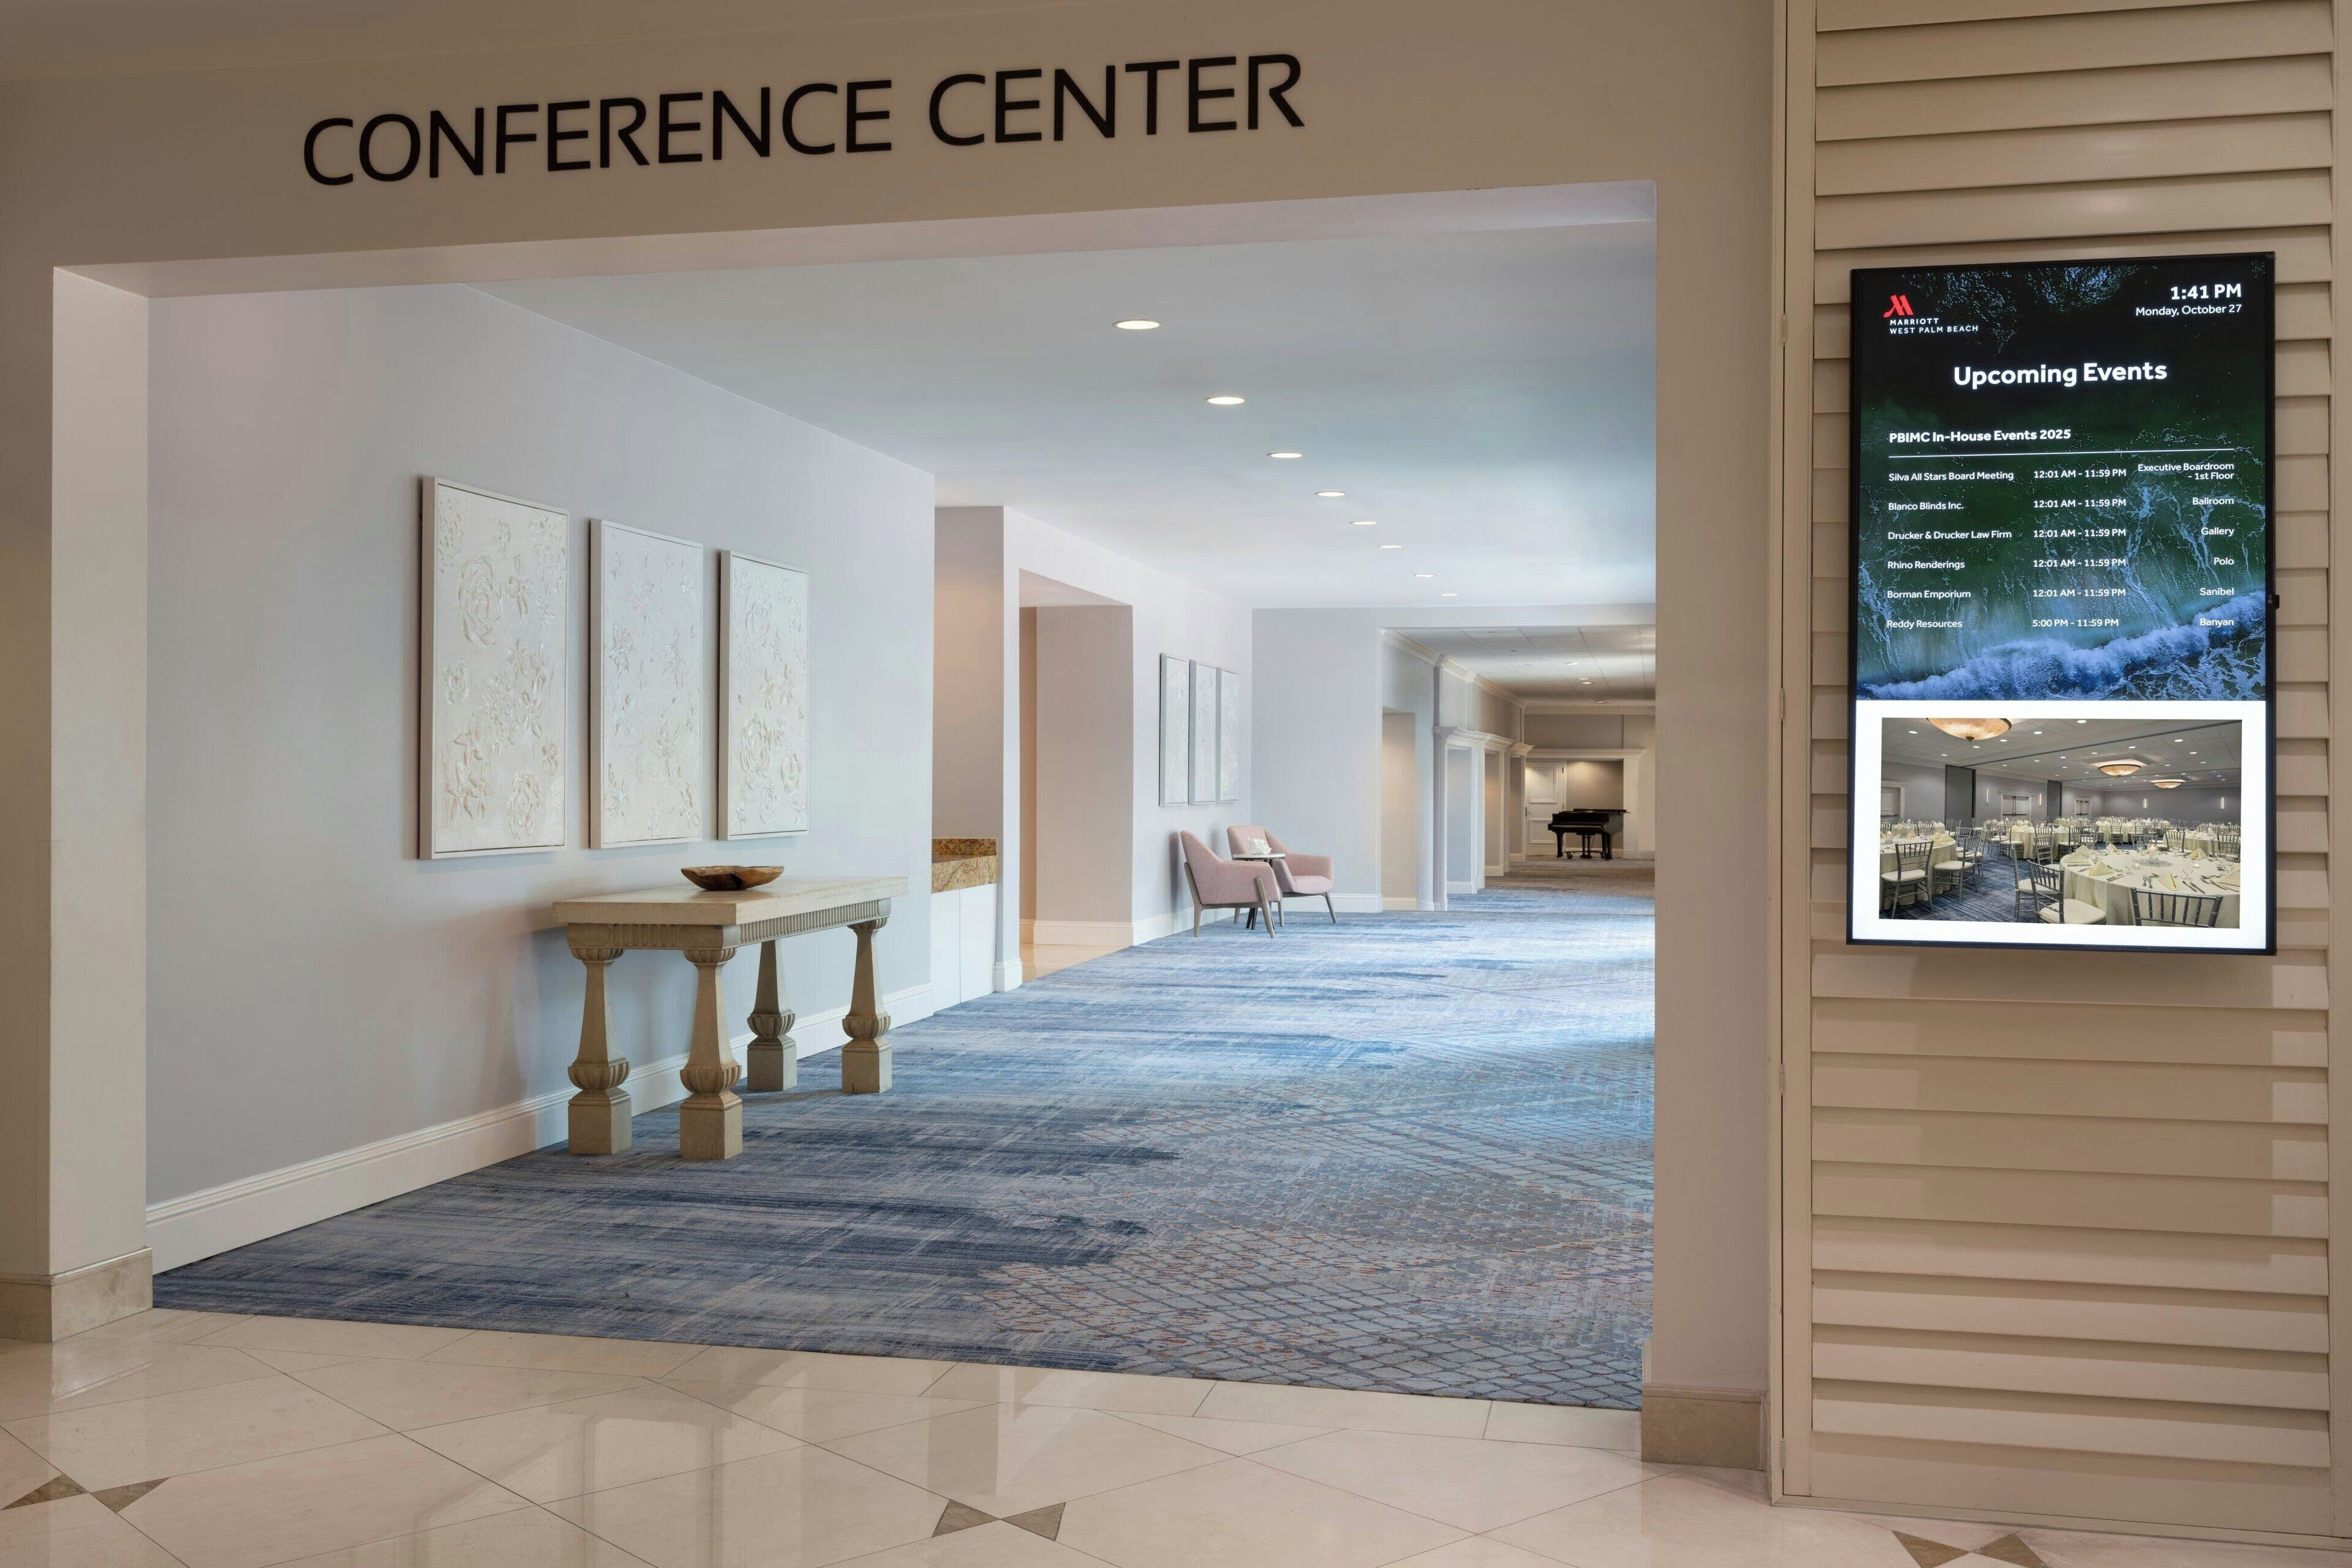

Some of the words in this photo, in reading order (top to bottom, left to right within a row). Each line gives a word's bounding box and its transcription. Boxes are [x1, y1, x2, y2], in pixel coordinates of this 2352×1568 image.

[304, 80, 891, 186] CONFERENCE
[929, 54, 1305, 146] CENTER
[2170, 285, 2209, 300] 1:41
[2214, 283, 2241, 298] PM
[2136, 306, 2179, 317] Monday,
[2181, 304, 2226, 314] October
[2228, 304, 2241, 312] 27
[1954, 364, 2076, 389] Upcoming
[2084, 362, 2167, 381] Events
[1889, 432, 1930, 443] PBIMC
[1932, 431, 1991, 442] In-House
[1994, 430, 2037, 440] Events
[2040, 429, 2070, 439] 2025
[1977, 471, 2013, 481] Meeting
[2111, 498, 2126, 507] PM
[2192, 496, 2234, 505] Ballroom
[2201, 527, 2234, 537] Gallery
[1915, 560, 1965, 570] Renderings
[1887, 590, 1922, 598] Borman
[1923, 590, 1970, 600] Emporium
[1887, 619, 1915, 630] Reddy
[2054, 618, 2068, 627] PM
[2104, 617, 2119, 626] PM
[2199, 617, 2234, 627] Banyan
